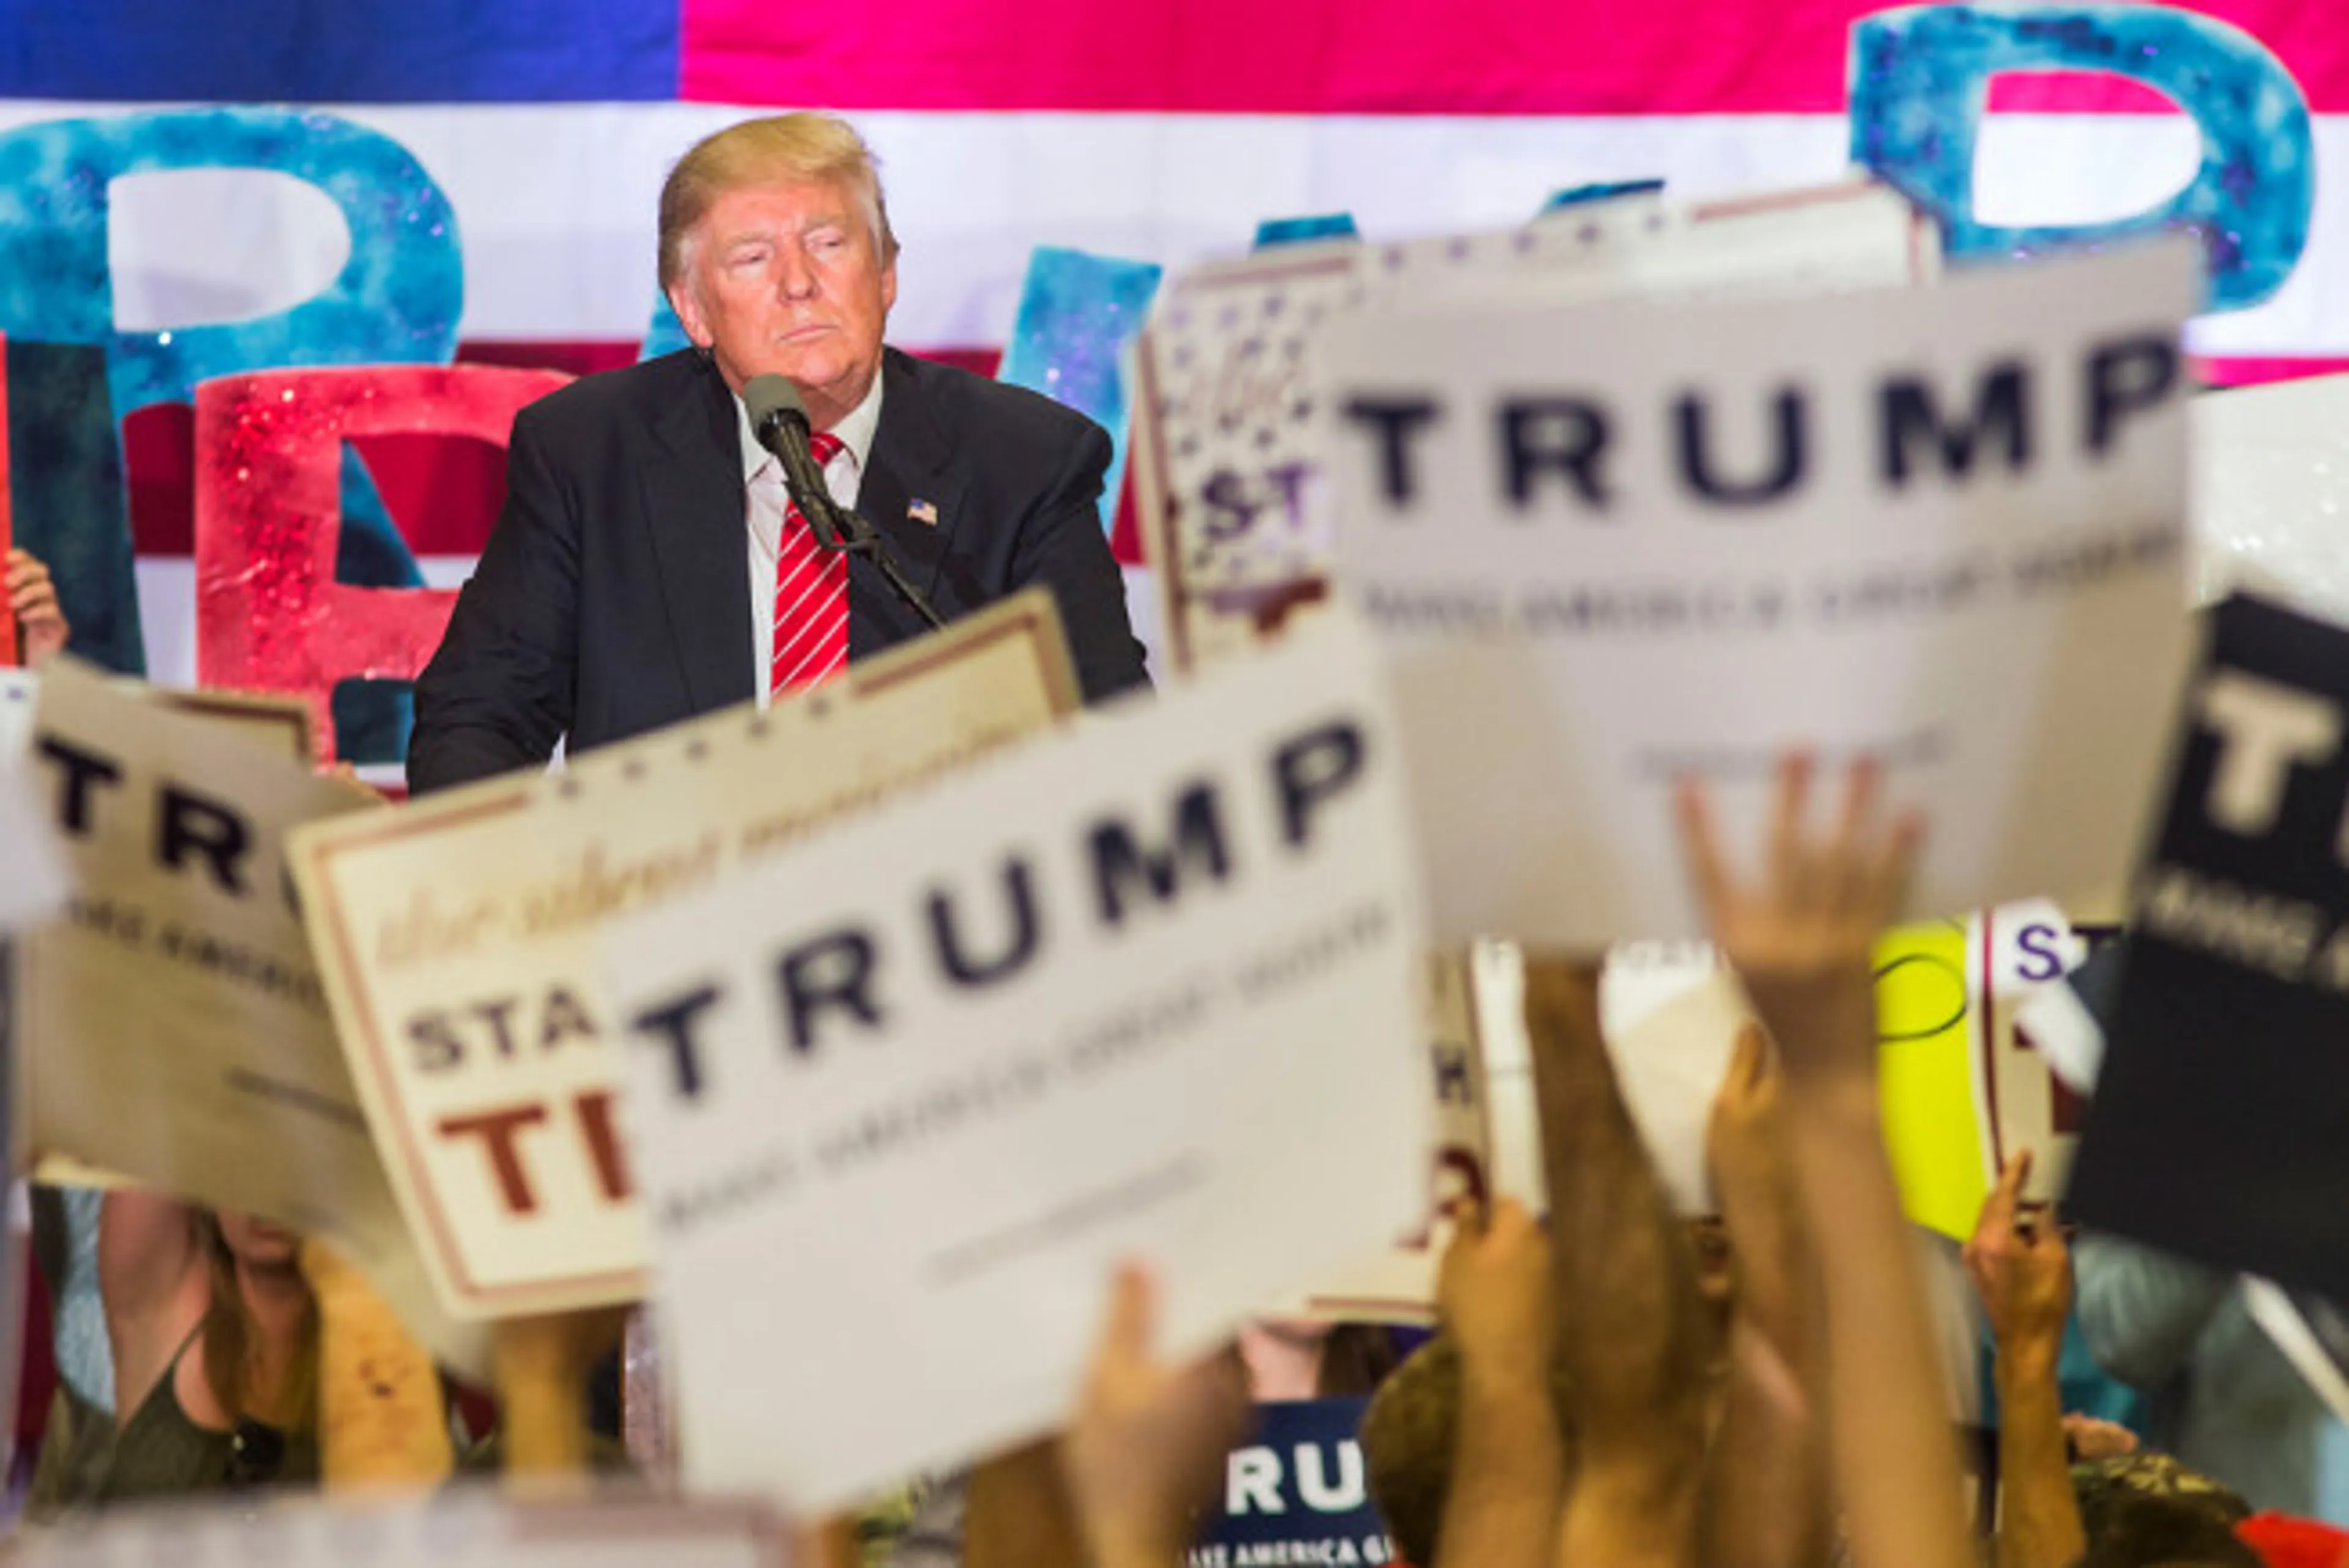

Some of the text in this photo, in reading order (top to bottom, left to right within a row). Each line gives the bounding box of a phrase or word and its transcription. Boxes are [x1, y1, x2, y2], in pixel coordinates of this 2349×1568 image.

[1341, 330, 2179, 509] TRUMP
[37, 729, 300, 921] TR
[2203, 664, 2349, 862] T
[630, 720, 1367, 1098] TRUMP
[1235, 1536, 1360, 1566] AMERICA
